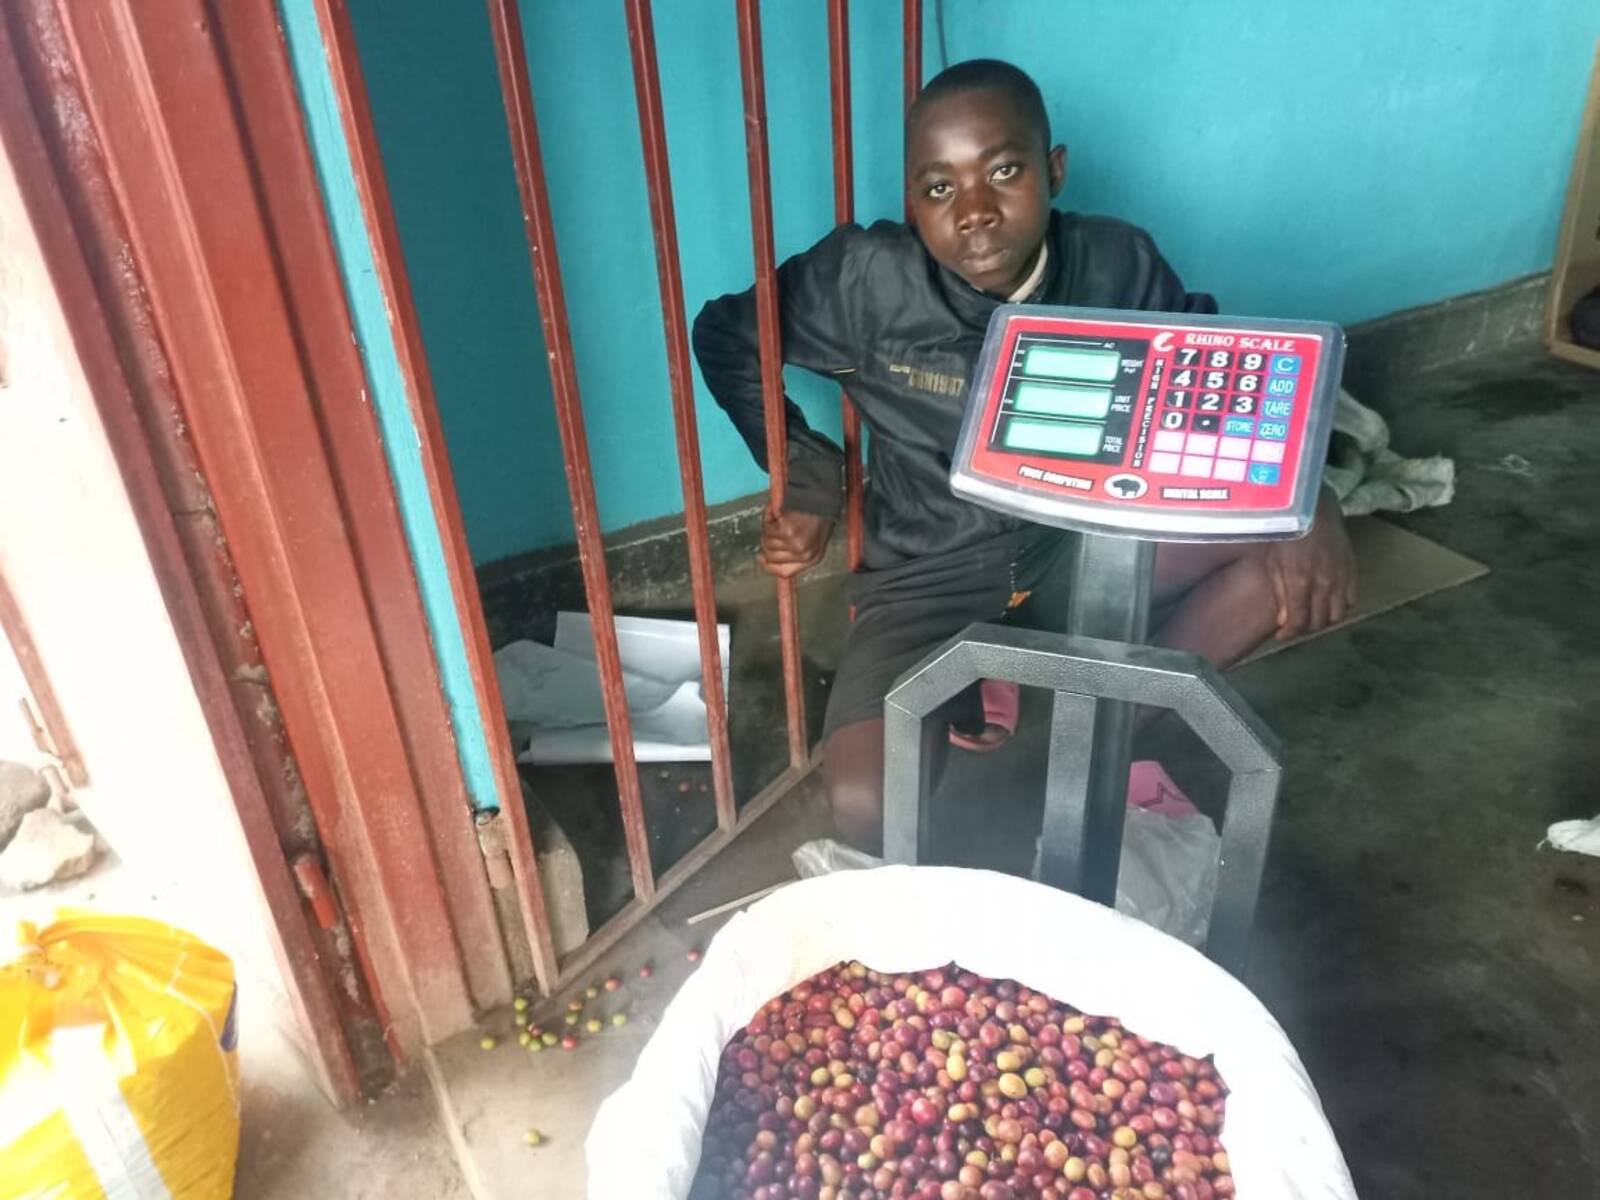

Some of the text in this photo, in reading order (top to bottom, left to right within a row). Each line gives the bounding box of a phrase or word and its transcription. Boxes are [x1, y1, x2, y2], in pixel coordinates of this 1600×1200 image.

[1185, 333, 1296, 352] RHINO SCALE
[1180, 348, 1294, 371] 7 8 9 C
[1174, 370, 1294, 394] 4 5 6 ADD
[1174, 391, 1290, 415] 1 2 3 TARE
[1165, 412, 1183, 429] 0
[1225, 420, 1253, 433] STORE
[1260, 423, 1285, 436] ZERO
